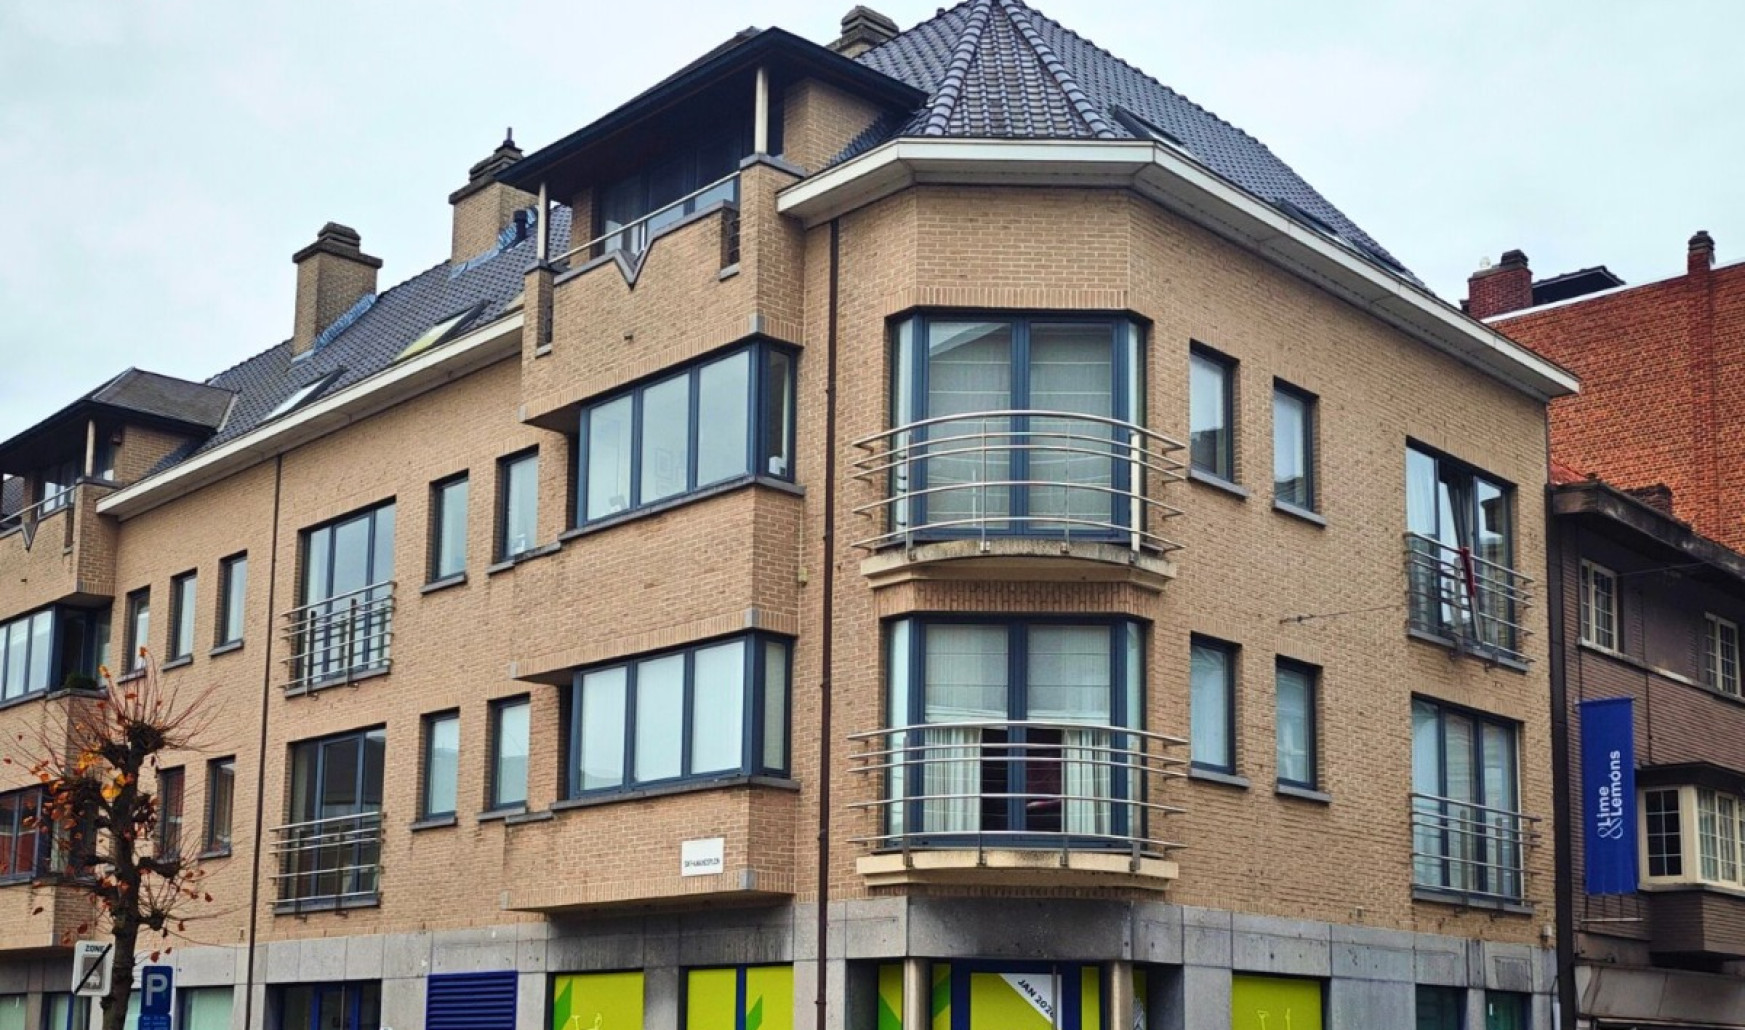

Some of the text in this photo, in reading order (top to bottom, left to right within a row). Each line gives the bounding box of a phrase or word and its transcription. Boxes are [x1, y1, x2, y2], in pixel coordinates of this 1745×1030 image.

[1596, 786, 1611, 827] Lime
[1597, 750, 1623, 839] & Lemons
[146, 973, 168, 1006] P
[1018, 979, 1037, 998] JAN
